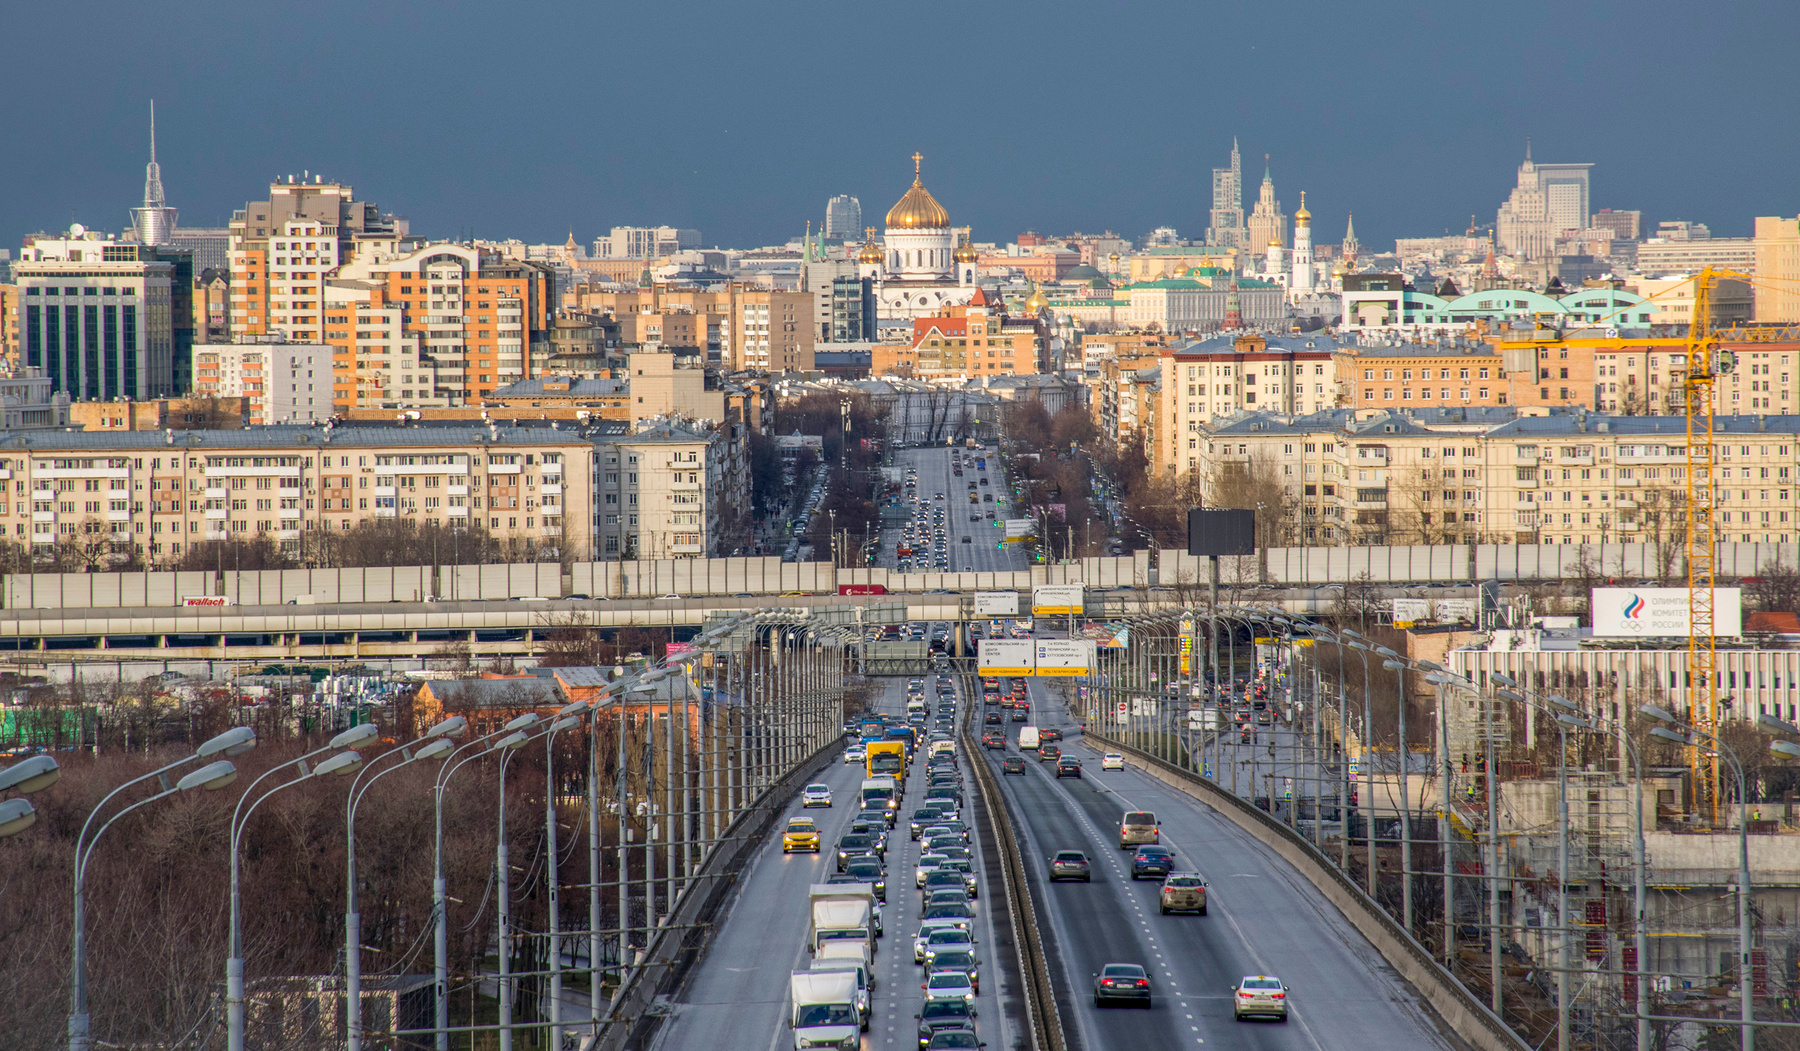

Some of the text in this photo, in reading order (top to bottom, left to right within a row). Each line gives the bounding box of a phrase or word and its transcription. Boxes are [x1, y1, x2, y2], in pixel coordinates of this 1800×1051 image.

[187, 598, 225, 606] wallach
[1652, 609, 1687, 617] КОМИТЕТ
[1652, 621, 1684, 629] РОССИИ
